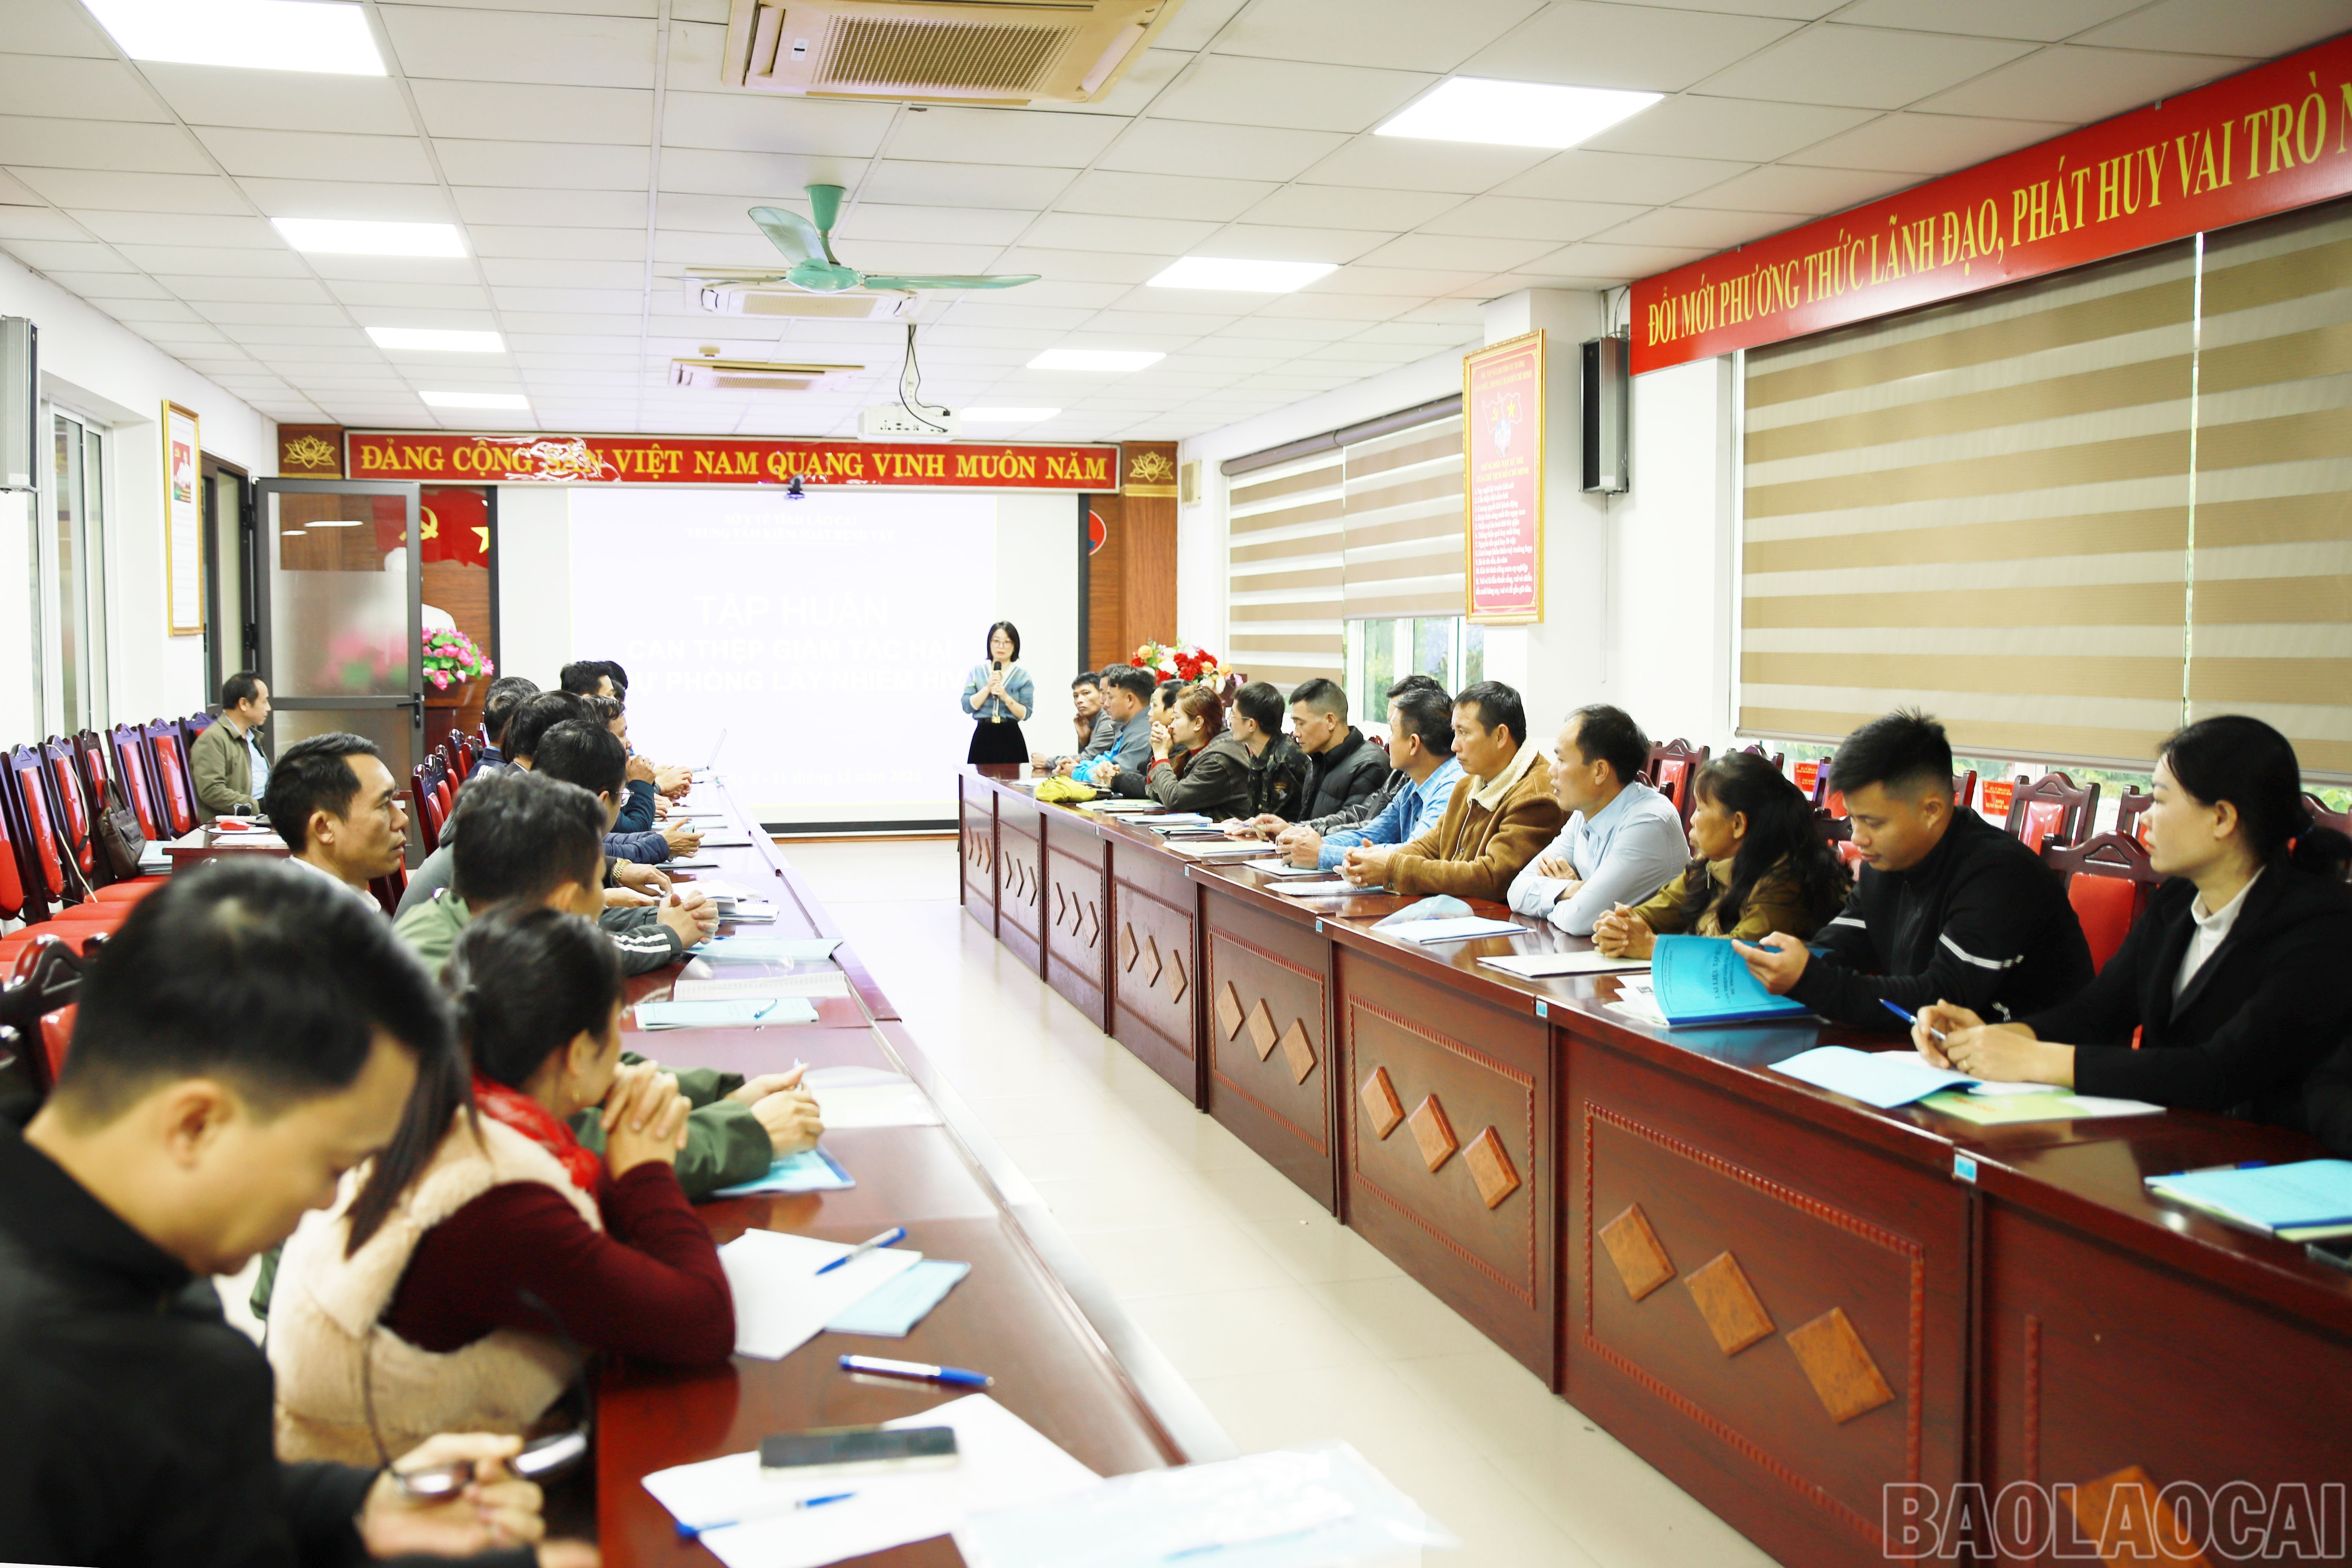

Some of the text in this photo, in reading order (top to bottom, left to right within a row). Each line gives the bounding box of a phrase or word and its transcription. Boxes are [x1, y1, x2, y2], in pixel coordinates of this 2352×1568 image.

[1649, 286, 1678, 346] ĐỔI
[1681, 274, 1715, 338] MỚI
[1719, 259, 1799, 327] PHƯƠNG
[1804, 229, 1865, 304] THỨC
[1870, 215, 1936, 286] LÃNH
[1943, 198, 2004, 276] ĐẠO,
[2011, 156, 2090, 247] PHÁT
[2097, 142, 2168, 223] HUY
[2175, 120, 2236, 198] VAI
[2244, 71, 2327, 180] TRÒ
[362, 437, 445, 470] ĐẢNG
[453, 439, 534, 476] CỘNG
[612, 444, 683, 479] VIỆT
[694, 451, 758, 474] NAM
[767, 452, 864, 480] QUANG
[872, 453, 945, 477] VINH
[956, 449, 1036, 479] MUÔN
[1046, 450, 1107, 480] NĂM
[693, 589, 889, 632] TẬP HUẤN
[627, 638, 685, 661] CAN
[772, 634, 841, 660] GIẢM
[848, 634, 901, 660] TÁC
[909, 639, 953, 665] HẠI
[666, 666, 764, 692] PHÒNG
[772, 665, 824, 691] LÂY
[831, 666, 913, 691] NHIỄM
[922, 670, 965, 691] HIV
